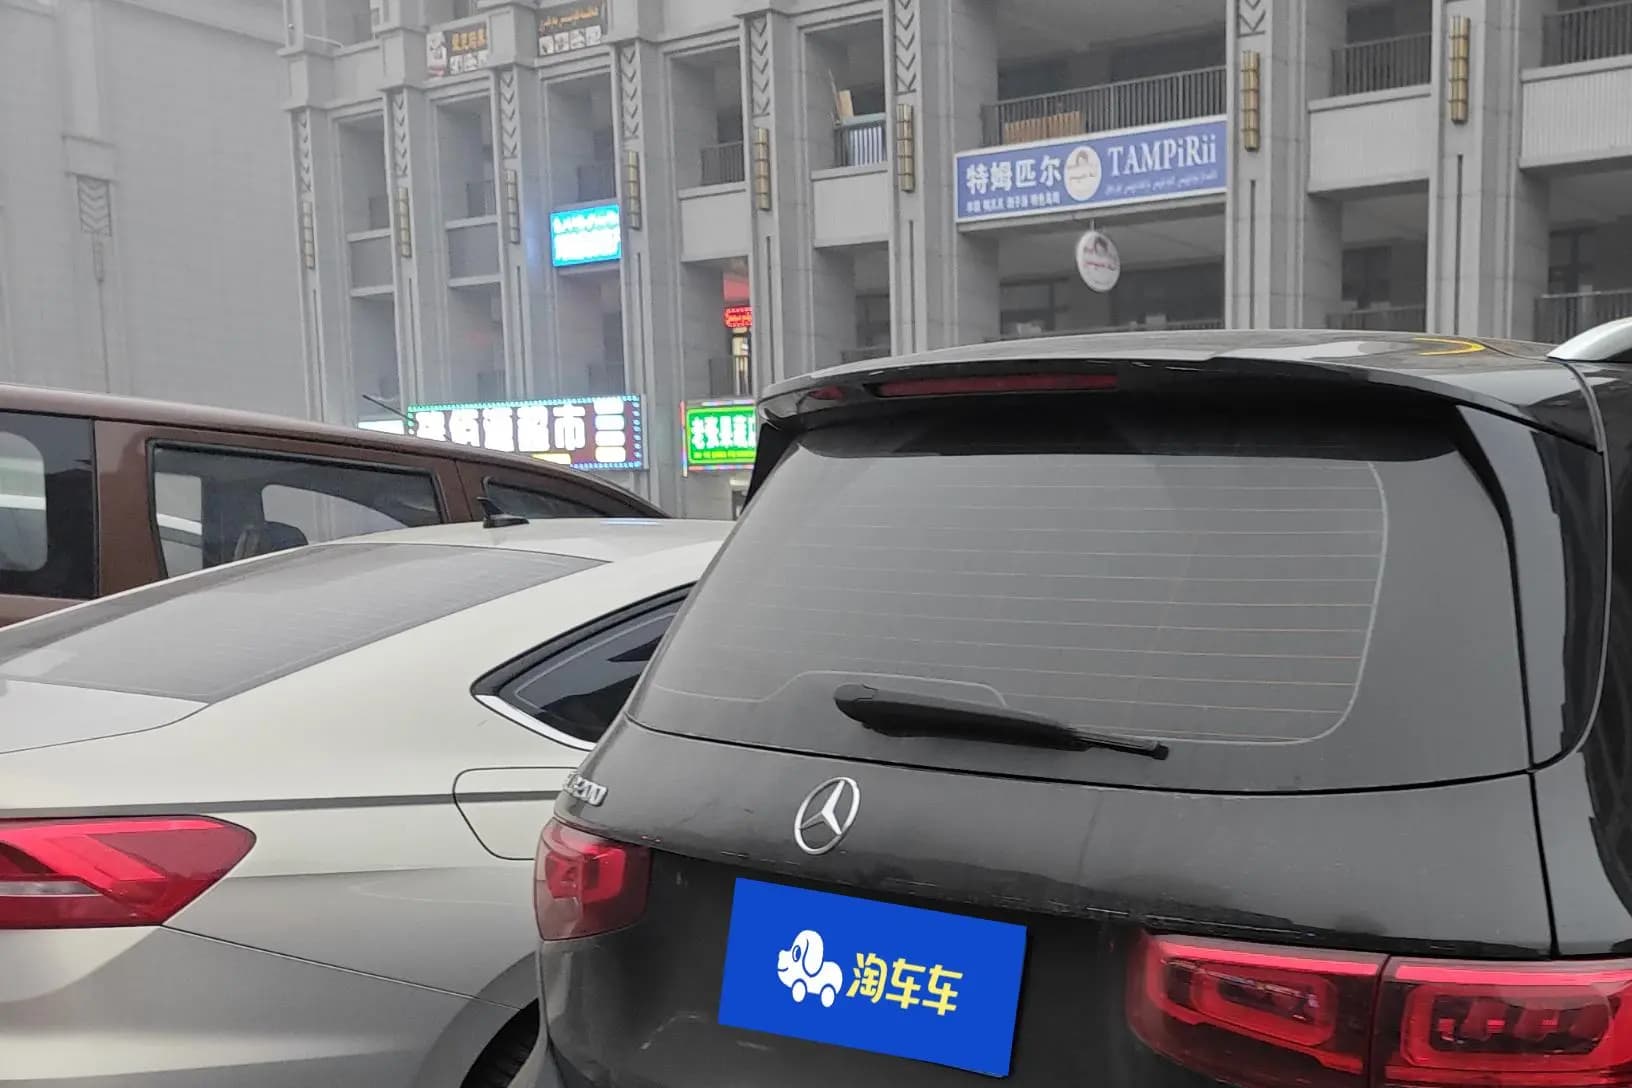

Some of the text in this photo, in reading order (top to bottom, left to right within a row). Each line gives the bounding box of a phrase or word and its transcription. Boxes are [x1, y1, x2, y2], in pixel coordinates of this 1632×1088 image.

[966, 155, 1062, 195] 特姆匹尔
[1108, 134, 1217, 177] TAMPiRii
